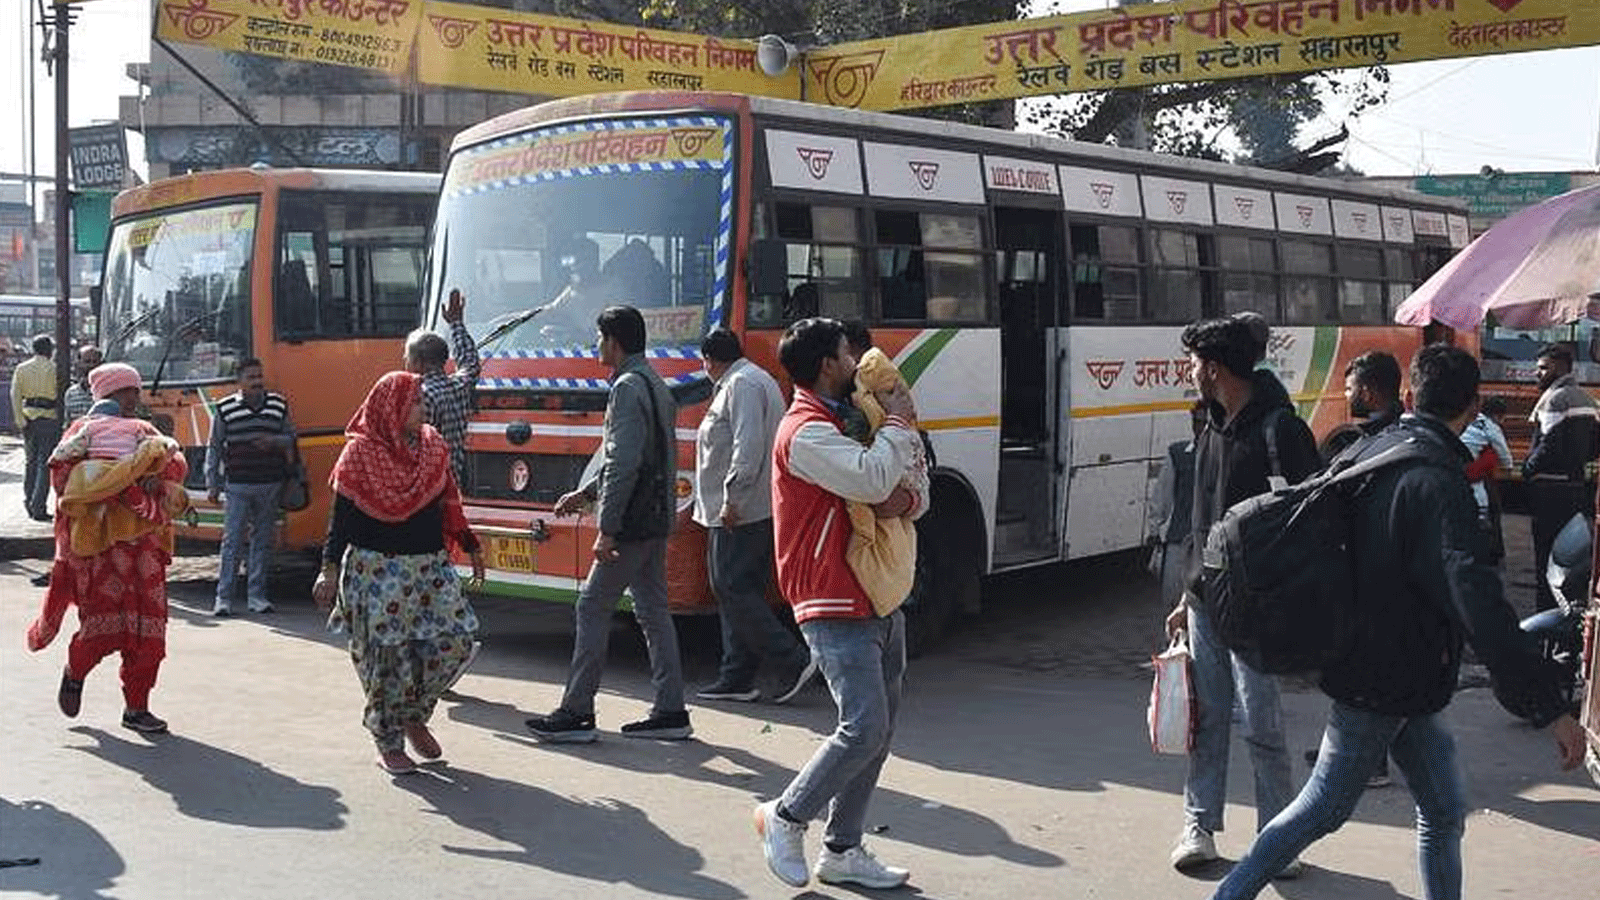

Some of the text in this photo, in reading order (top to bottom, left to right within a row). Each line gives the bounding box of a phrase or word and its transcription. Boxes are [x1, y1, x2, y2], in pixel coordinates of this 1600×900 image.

[486, 18, 758, 73] उत्तर प्रदेश परिवहन निगम
[983, 25, 1062, 67] उत्तर
[1077, 10, 1175, 54] प्रदेश
[487, 45, 517, 71] रेलवे
[555, 62, 576, 80] बस
[587, 63, 624, 84] स्टेशन
[1016, 32, 1400, 88] रेलवे रोड बस स्टेशन सहारनपुर
[73, 144, 120, 165] INDRA
[574, 131, 668, 162] परिवहन
[76, 163, 123, 184] LODGE
[1133, 360, 1170, 387] उत्तर
